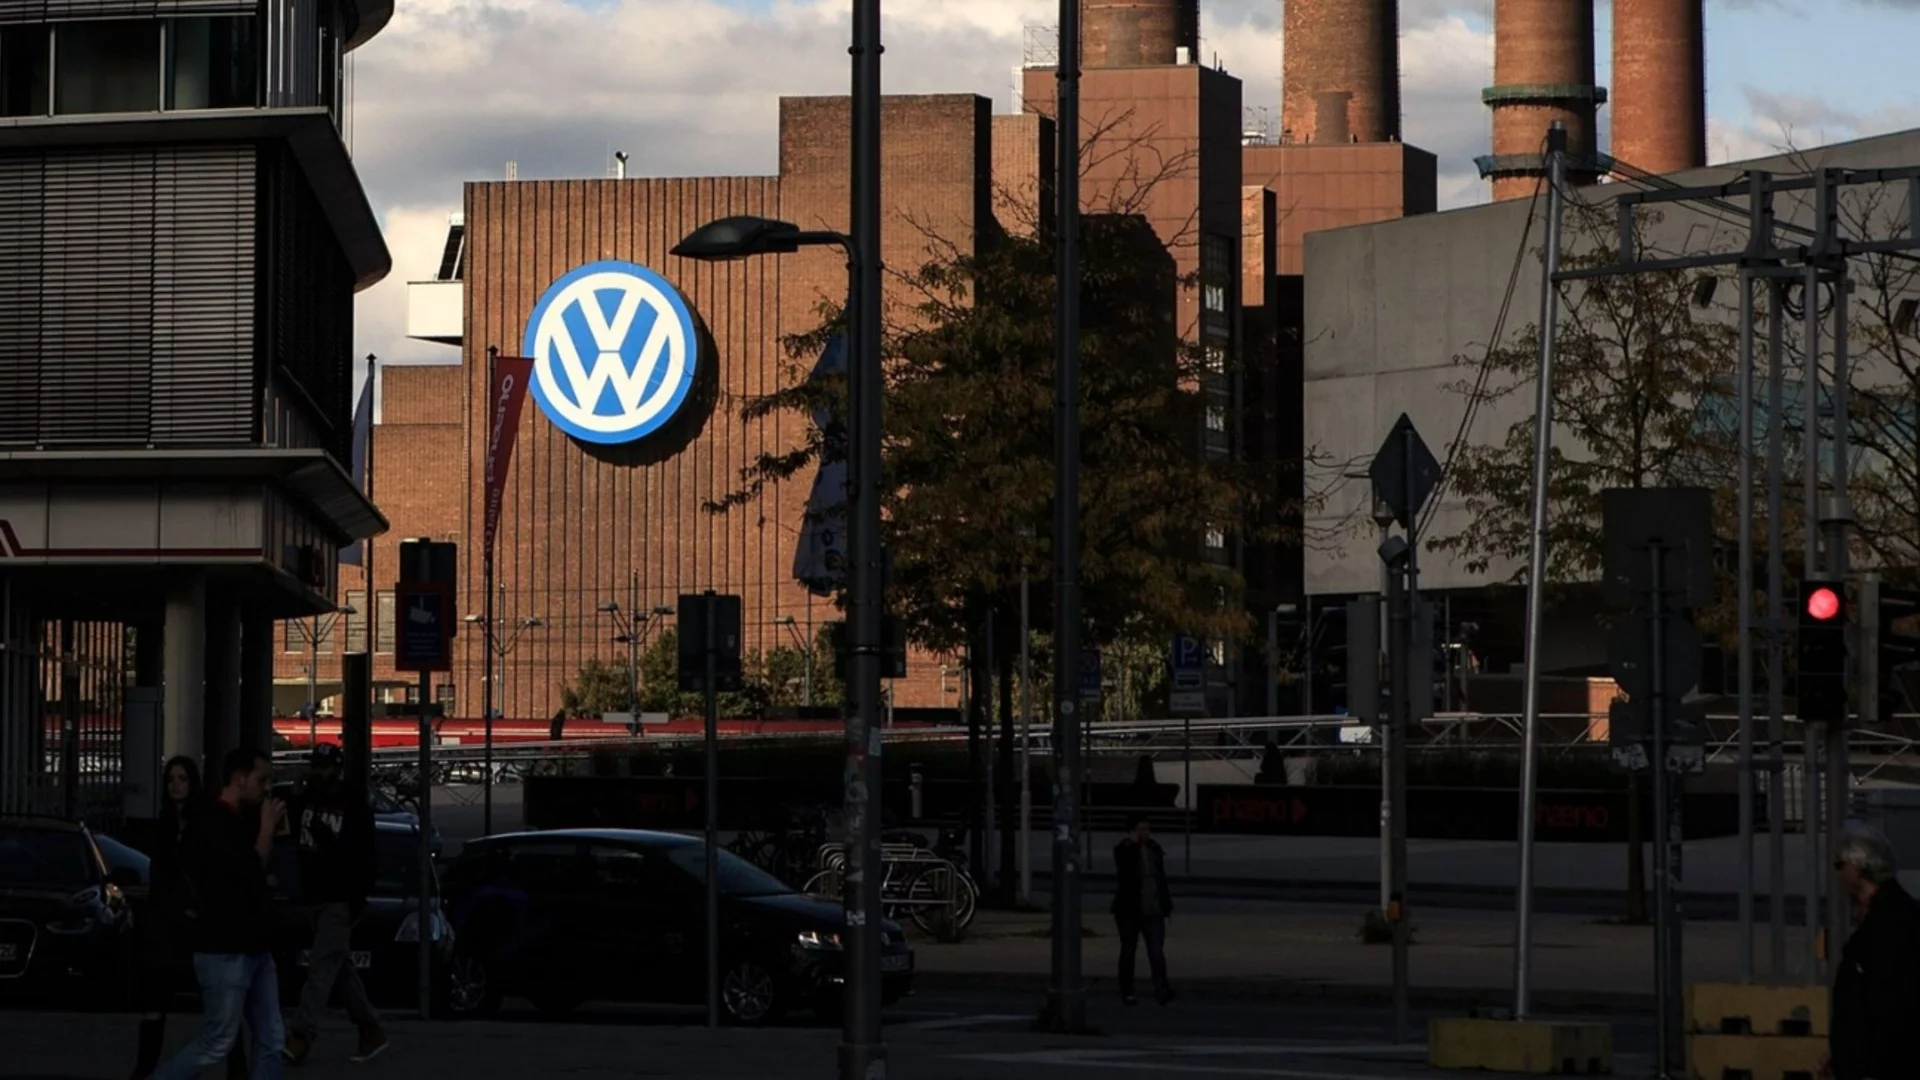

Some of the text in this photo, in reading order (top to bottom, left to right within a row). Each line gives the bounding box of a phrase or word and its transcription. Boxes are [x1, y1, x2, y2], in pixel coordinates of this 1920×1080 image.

[534, 272, 685, 432] VW
[1180, 636, 1199, 666] P
[1536, 796, 1610, 829] haeno
